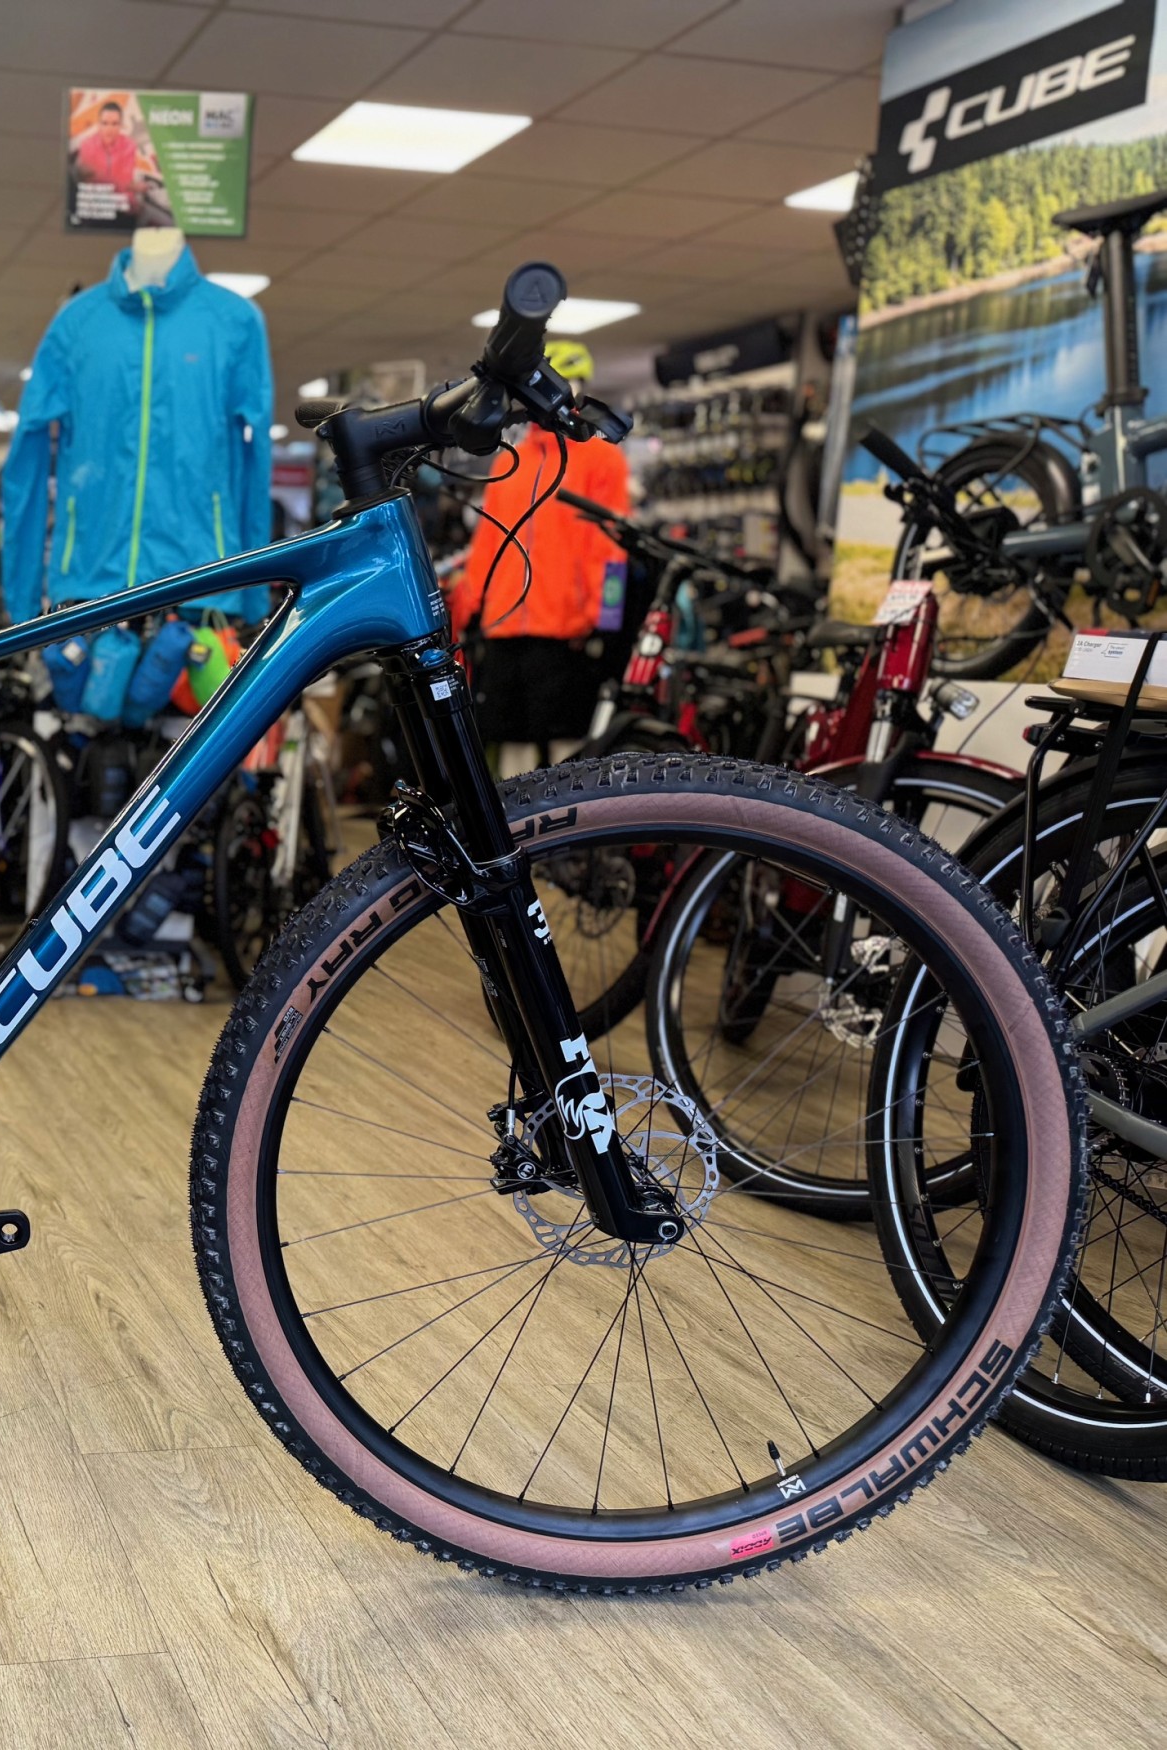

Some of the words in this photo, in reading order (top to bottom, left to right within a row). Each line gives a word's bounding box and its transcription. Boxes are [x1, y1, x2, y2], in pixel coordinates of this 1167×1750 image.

[945, 34, 1136, 140] CUBE
[306, 910, 383, 1004] RAY
[775, 1337, 1013, 1544] SCHWALBE
[730, 1535, 772, 1556] ADDIX
